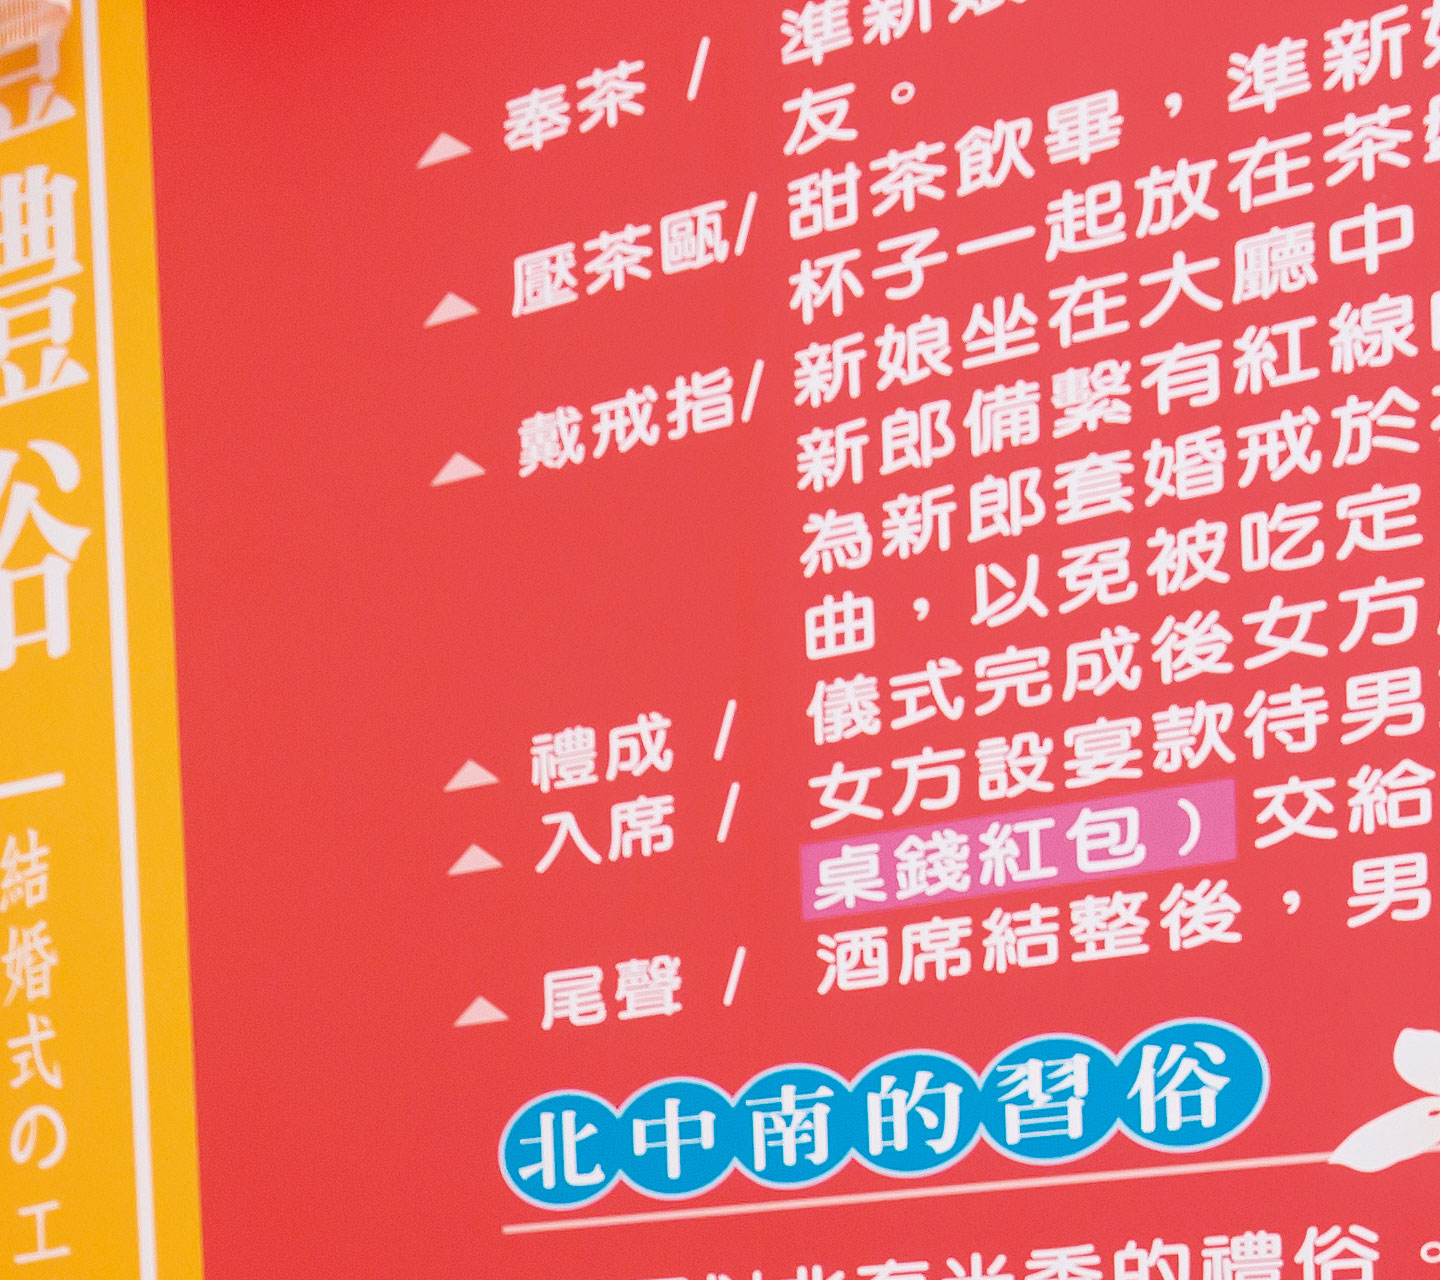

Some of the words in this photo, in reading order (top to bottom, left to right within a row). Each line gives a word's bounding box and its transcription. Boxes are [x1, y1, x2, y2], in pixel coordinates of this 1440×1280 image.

[504, 60, 647, 152] 奉茶
[782, 81, 917, 157] 友。
[530, 712, 674, 795] 禮成
[535, 795, 676, 874] 入席
[541, 956, 683, 1031] 尾聲
[518, 1040, 1233, 1191] 北中南的習俗
